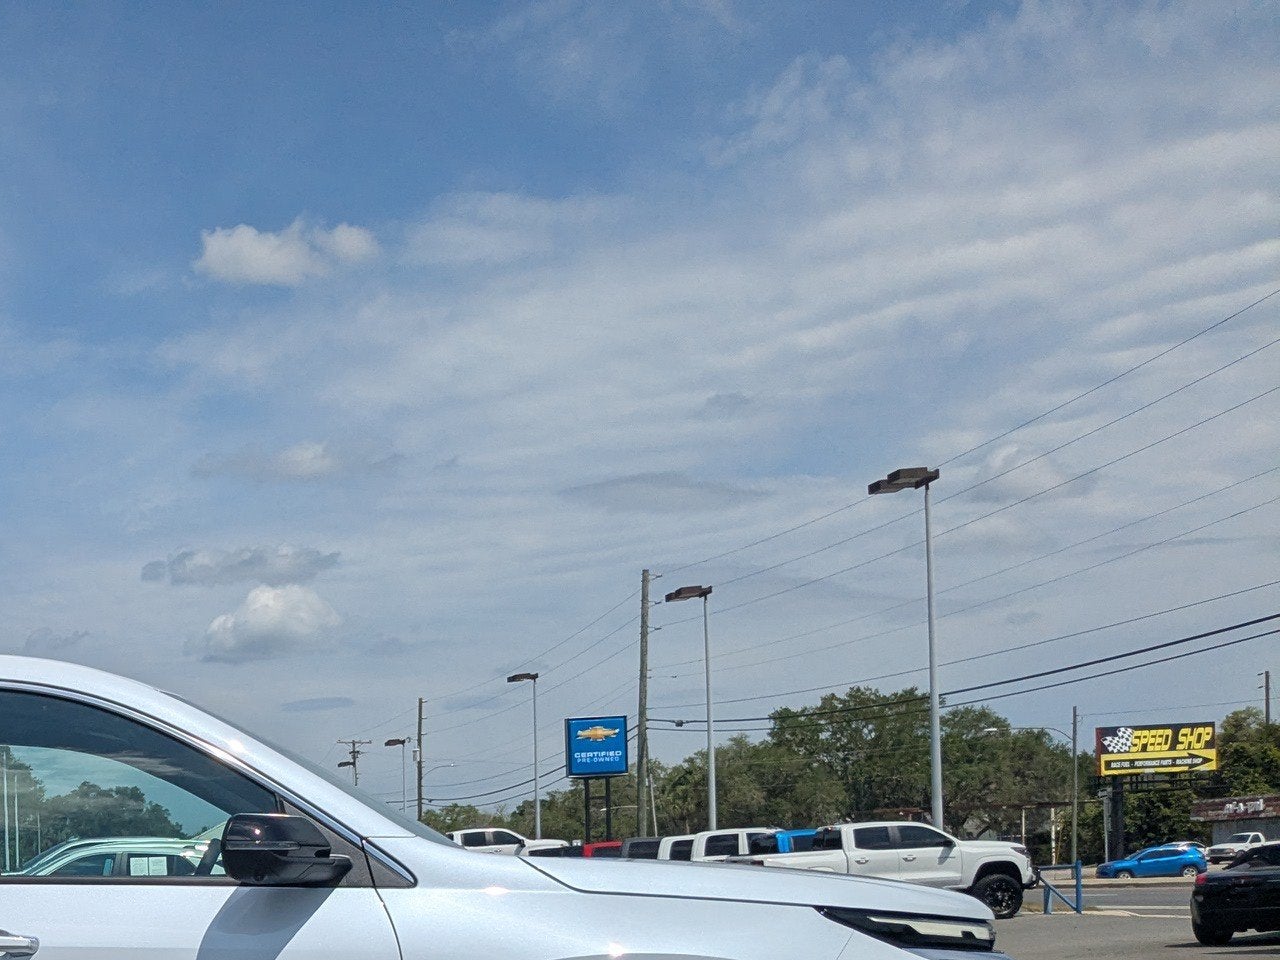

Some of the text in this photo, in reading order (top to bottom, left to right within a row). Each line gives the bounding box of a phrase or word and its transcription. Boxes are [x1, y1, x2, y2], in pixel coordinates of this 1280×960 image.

[1129, 726, 1213, 753] SPEED SHOP
[574, 750, 622, 758] CERTIFIED
